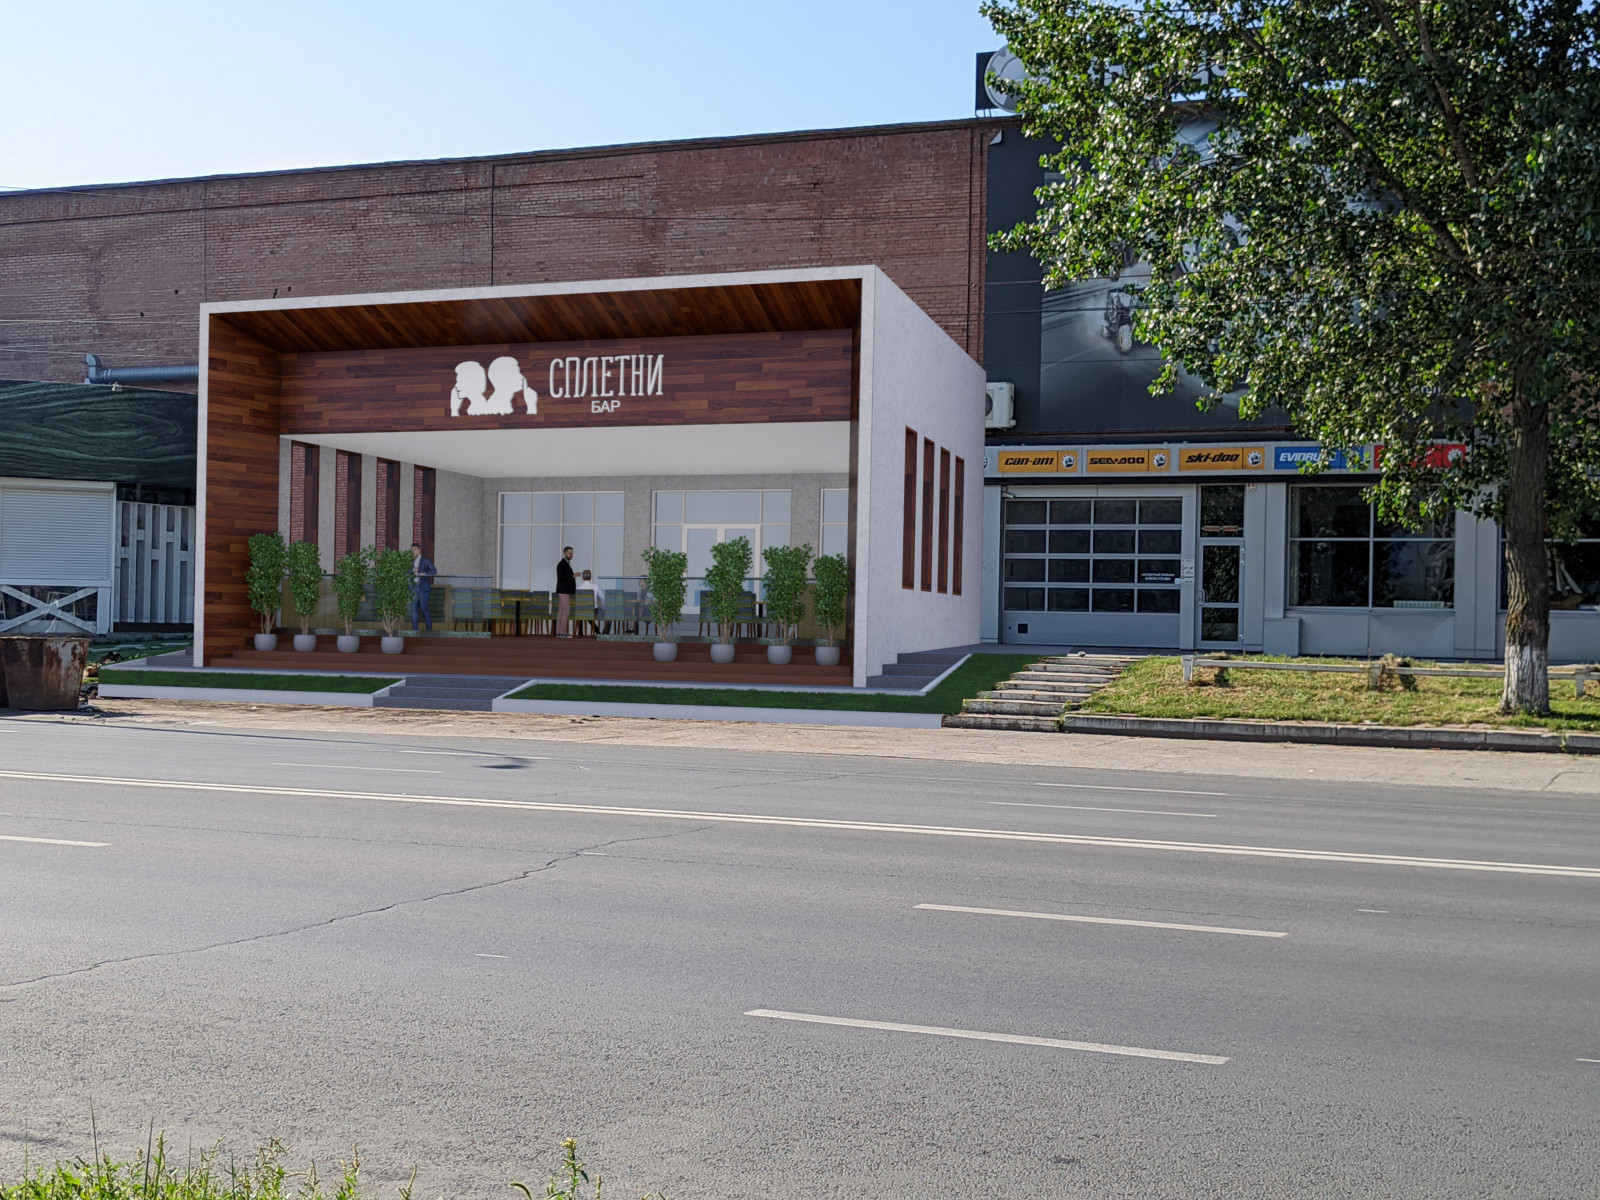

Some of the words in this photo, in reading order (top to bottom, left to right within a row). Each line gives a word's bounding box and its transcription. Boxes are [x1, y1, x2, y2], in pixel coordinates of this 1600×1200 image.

[549, 354, 664, 398] СПЛЕТНИ
[591, 400, 621, 413] БАР
[1004, 457, 1054, 466] can-am
[1185, 452, 1240, 463] ski-doo
[1279, 452, 1336, 462] EVINRU
